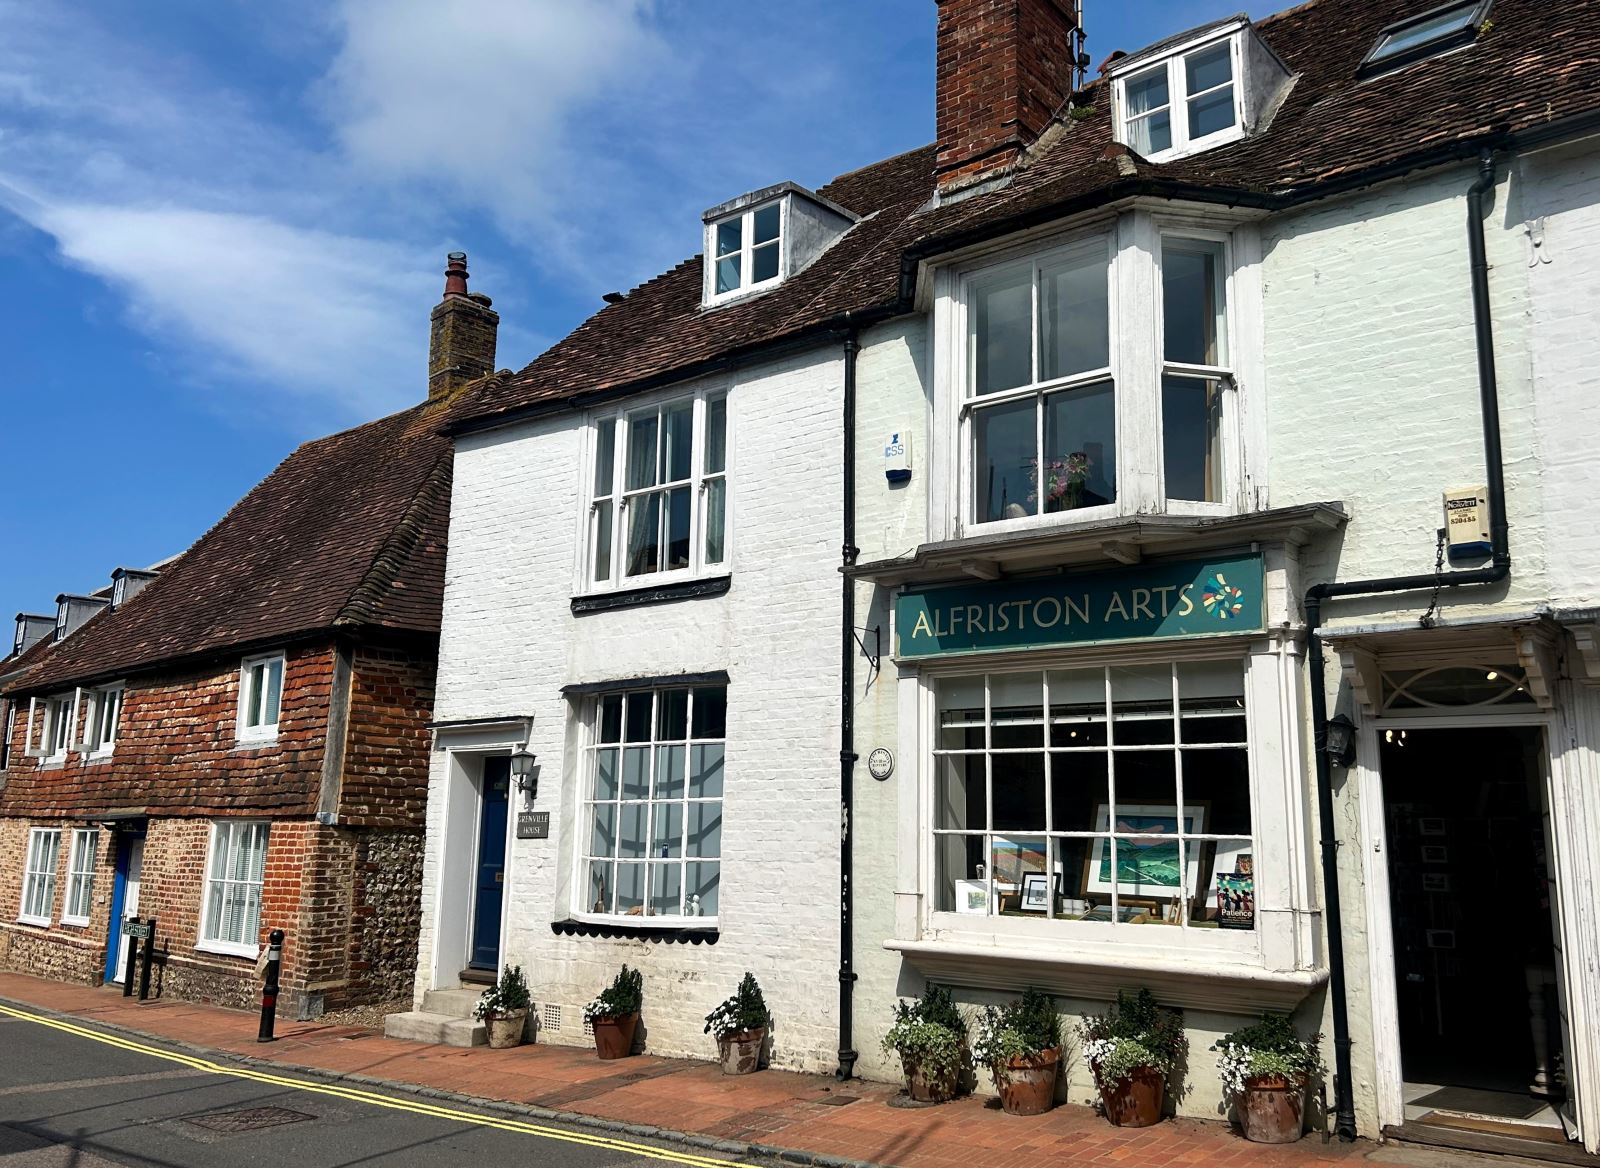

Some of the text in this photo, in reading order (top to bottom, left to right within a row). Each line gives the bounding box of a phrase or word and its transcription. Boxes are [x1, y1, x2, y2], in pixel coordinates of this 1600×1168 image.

[911, 583, 1194, 639] ALFRISTON ARTS
[518, 814, 548, 823] GRENVILLE
[523, 826, 541, 834] HOUSE
[1221, 908, 1253, 918] Patience
